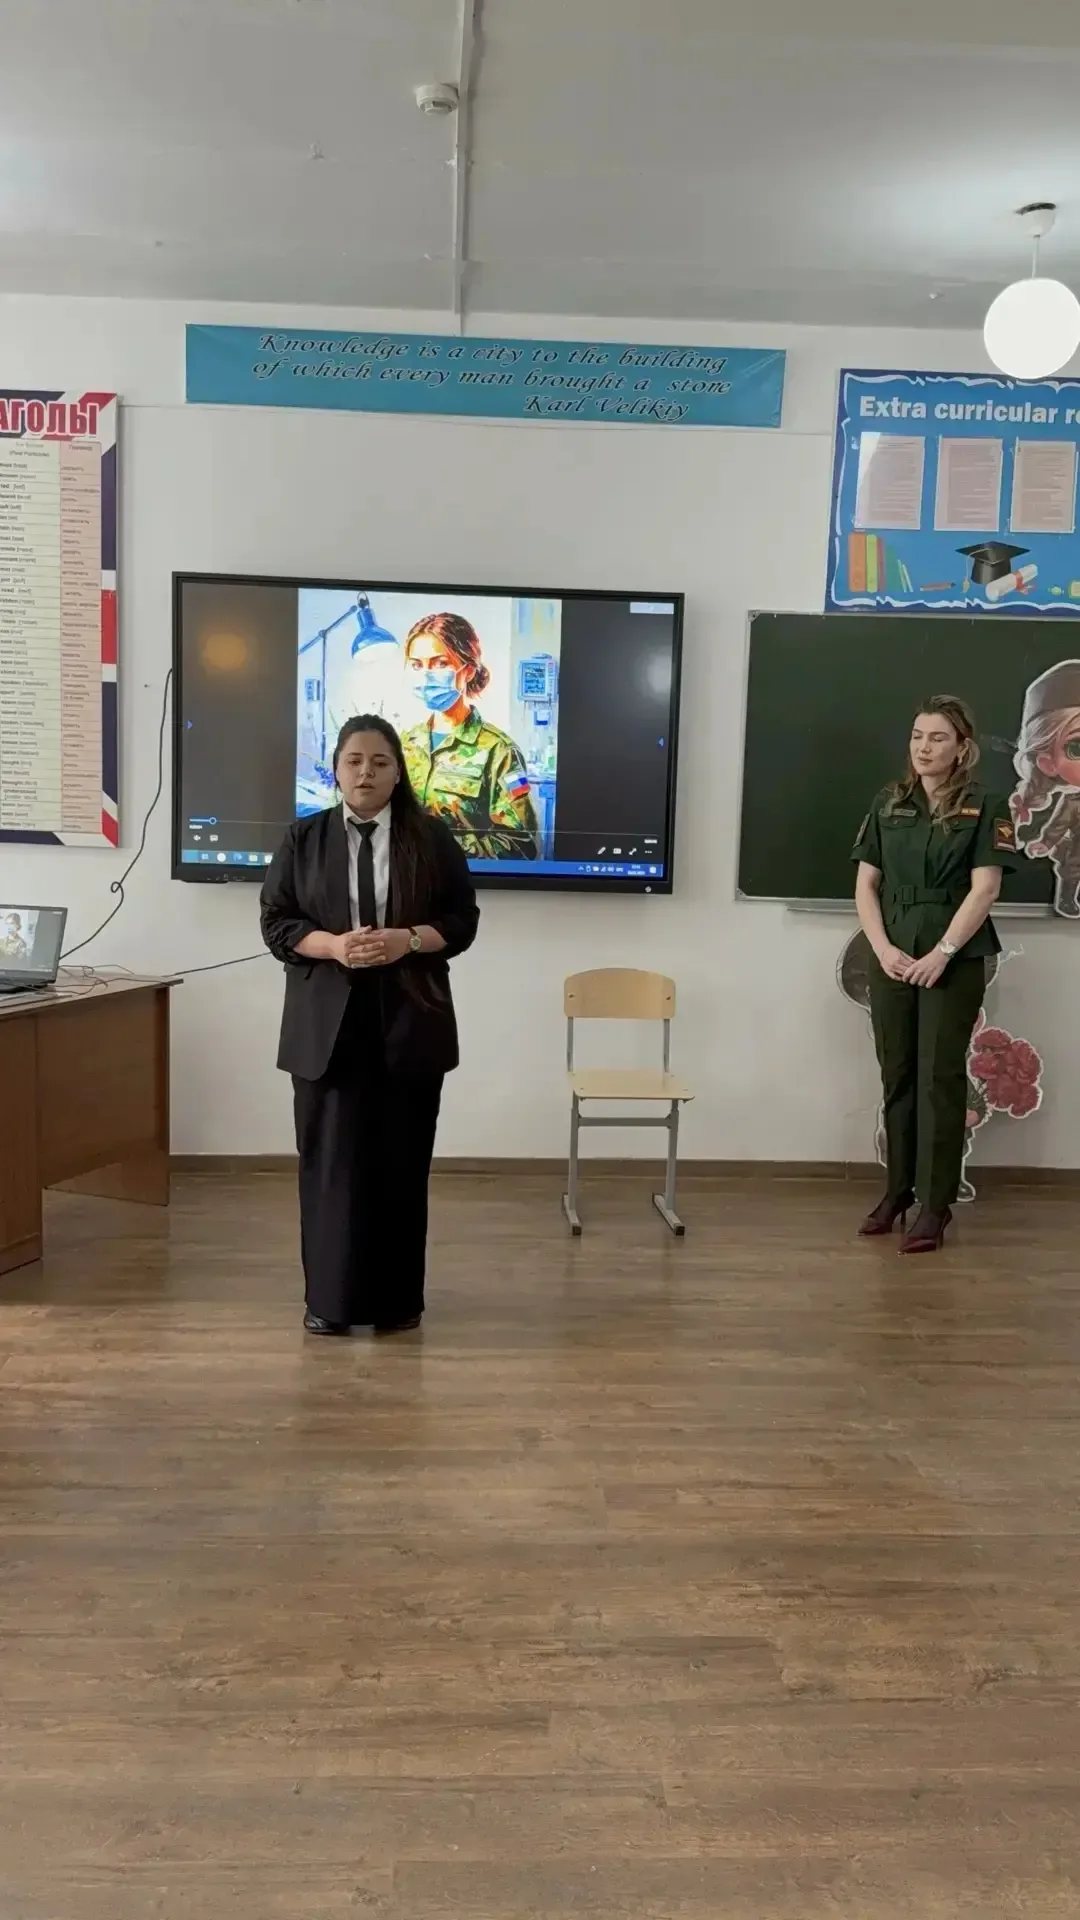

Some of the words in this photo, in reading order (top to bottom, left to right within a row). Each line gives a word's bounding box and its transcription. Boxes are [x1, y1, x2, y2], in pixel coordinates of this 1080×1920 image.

[258, 334, 408, 361] Knowledge
[418, 342, 441, 358] is
[447, 346, 465, 359] a
[471, 344, 524, 367] city
[531, 346, 558, 362] to
[567, 346, 609, 366] the
[618, 349, 728, 375] building
[252, 358, 290, 379] of
[291, 360, 372, 380] which
[379, 368, 450, 387] every
[458, 371, 514, 385] man
[523, 368, 626, 394] brought
[633, 379, 651, 391] a
[524, 395, 587, 415] Karl
[594, 397, 690, 422] Velikiy
[859, 396, 927, 420] Extra
[933, 400, 1059, 424] curricular
